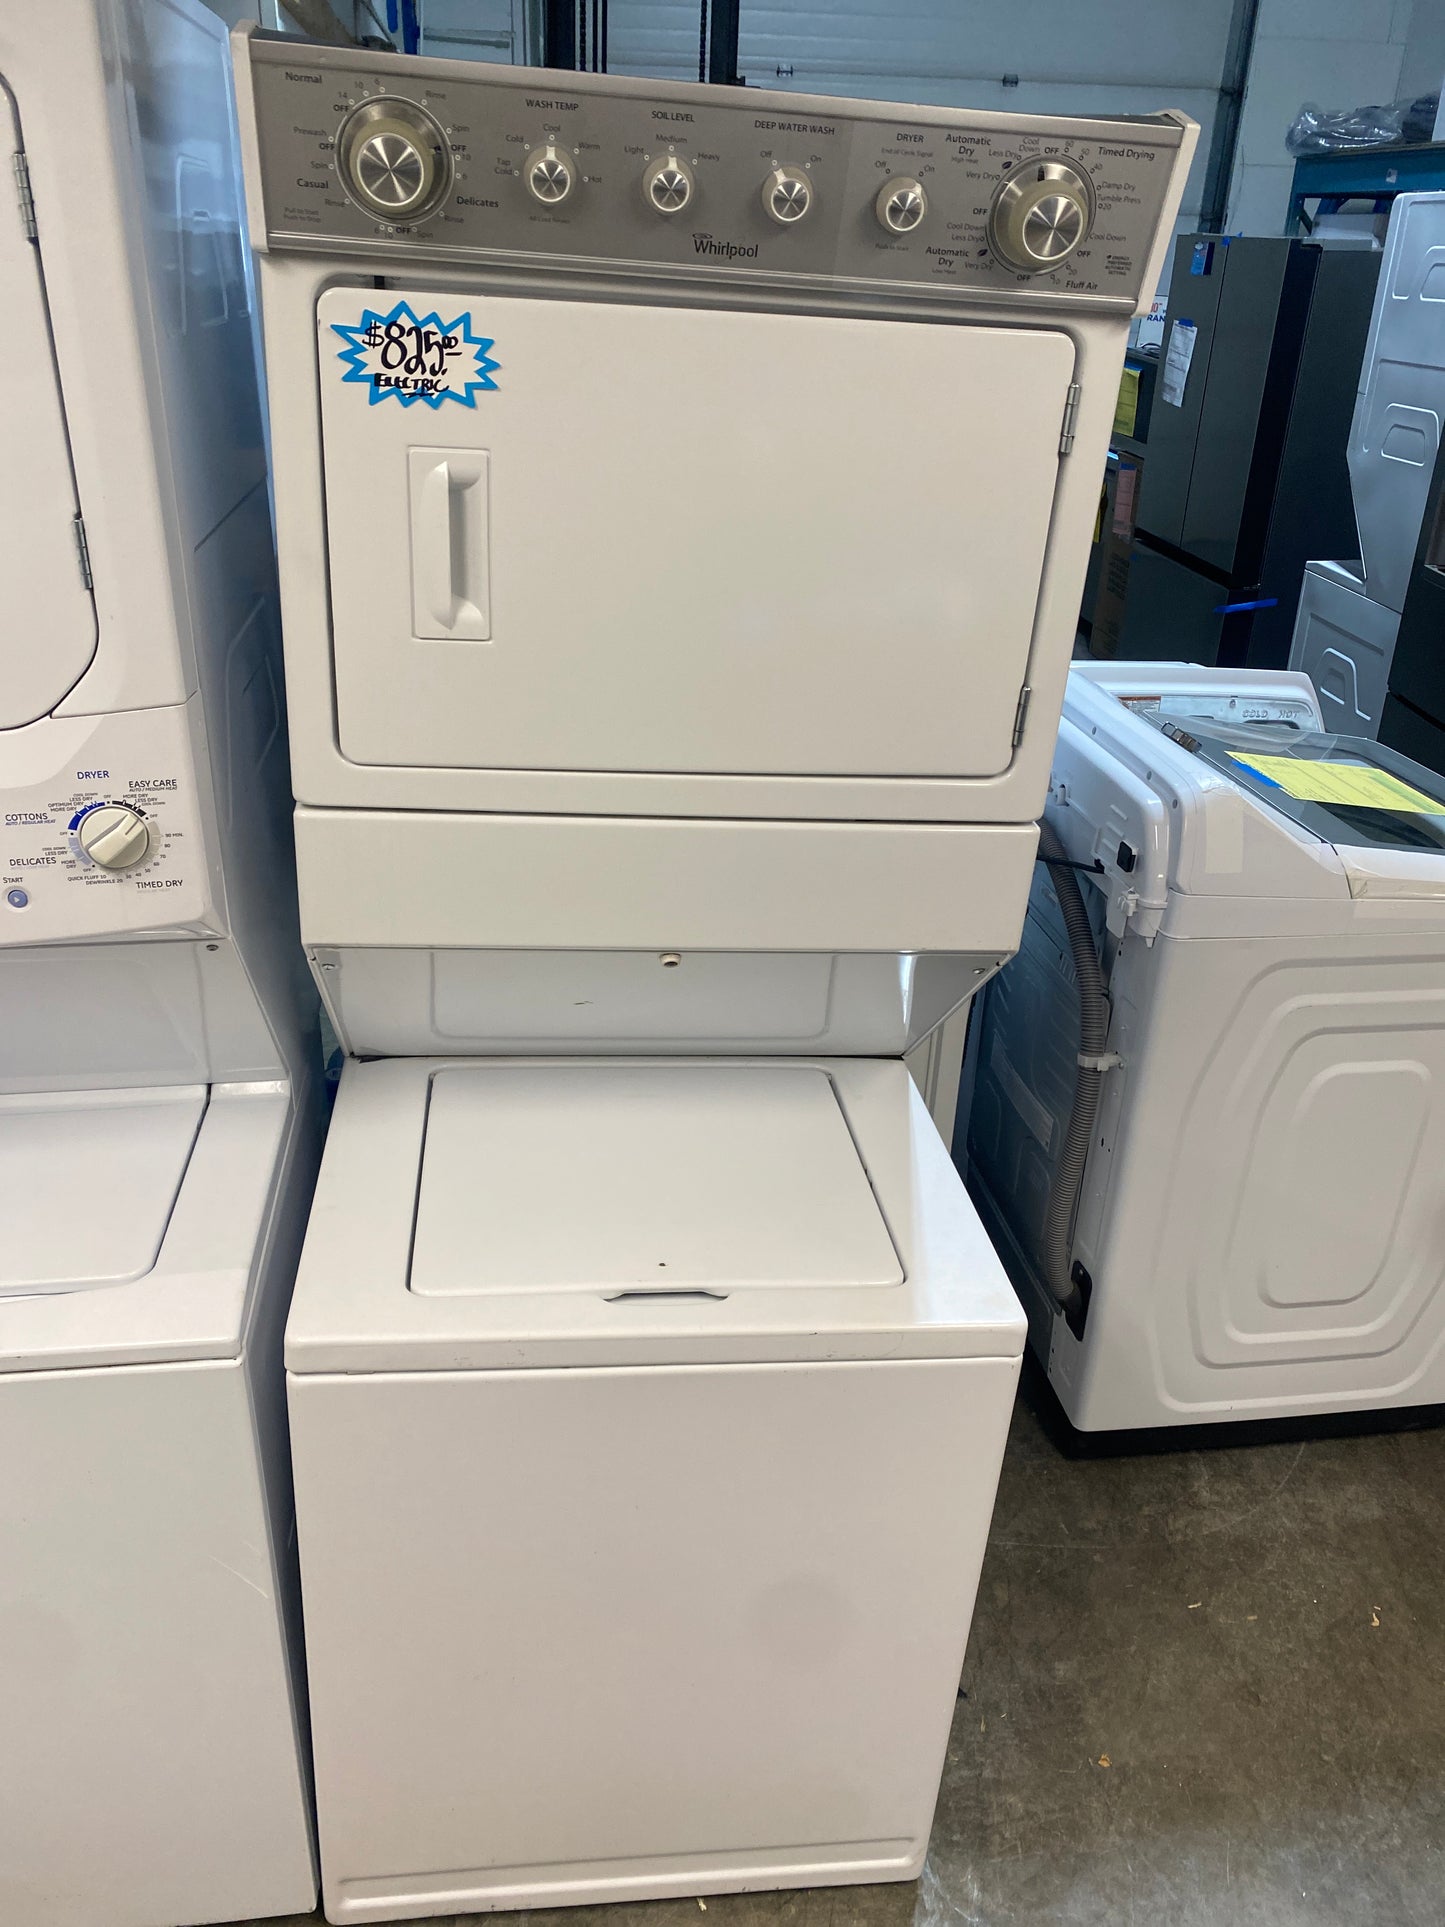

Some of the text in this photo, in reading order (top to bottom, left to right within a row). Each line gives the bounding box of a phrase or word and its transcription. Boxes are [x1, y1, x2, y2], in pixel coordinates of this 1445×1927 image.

[285, 72, 322, 84] Normal
[425, 90, 447, 100] Rinse
[333, 104, 350, 112] OFF
[525, 99, 579, 111] WASH TEMP
[651, 111, 695, 122] SOIL LEVEL
[293, 126, 327, 137] Prewash
[452, 124, 470, 133] Spin
[543, 123, 561, 132] Cool
[754, 120, 835, 136] DEEP WATER WASH
[505, 134, 524, 143] Cold
[655, 133, 688, 144] Medium
[896, 133, 925, 144] DRYER
[945, 134, 992, 146] Automatic
[1023, 137, 1040, 145] Cool
[319, 143, 336, 151] OFF
[451, 144, 467, 152] OFF
[578, 142, 601, 150] Warm
[624, 145, 645, 155] Light
[1019, 144, 1041, 153] Down
[760, 150, 773, 159] Off
[958, 146, 975, 157] Dry
[988, 148, 1016, 160] Less Dry
[1098, 146, 1155, 162] Timed Drying
[497, 157, 511, 167] Tap
[698, 152, 721, 162] Heavy
[810, 155, 822, 163] On
[311, 161, 328, 170] Spin
[875, 160, 887, 169] Off
[924, 164, 936, 173] On
[494, 167, 513, 176] Cold
[966, 171, 981, 180] Very
[296, 178, 329, 189] Casual
[1102, 181, 1136, 192] Damp Dry
[325, 199, 346, 208] Rinse
[457, 196, 499, 208] Delicates
[1098, 194, 1142, 205] Tumble Press
[973, 207, 989, 215] OFF
[1102, 203, 1112, 211] 20
[445, 215, 465, 225] Rinse
[395, 226, 411, 234] OFF
[947, 222, 985, 231] Cool Down
[417, 231, 434, 240] Spin
[1090, 233, 1127, 242] Cool Down
[693, 238, 759, 260] Whirlpool
[925, 246, 969, 257] Automatic
[1077, 250, 1091, 258] OFF
[938, 257, 954, 268] Dry
[965, 261, 994, 271] Very Dry
[1017, 274, 1031, 282] OFF
[1065, 280, 1098, 291] Fluff Air
[374, 373, 450, 393] ELECTRIC
[1242, 709, 1299, 719] COLD HOT
[77, 770, 110, 780] DRYER
[128, 779, 177, 788] EASY CARE
[5, 812, 48, 822] COTTONS
[9, 856, 57, 867] DELICATES
[3, 876, 23, 884] START
[136, 879, 183, 889] TIMED DRY
